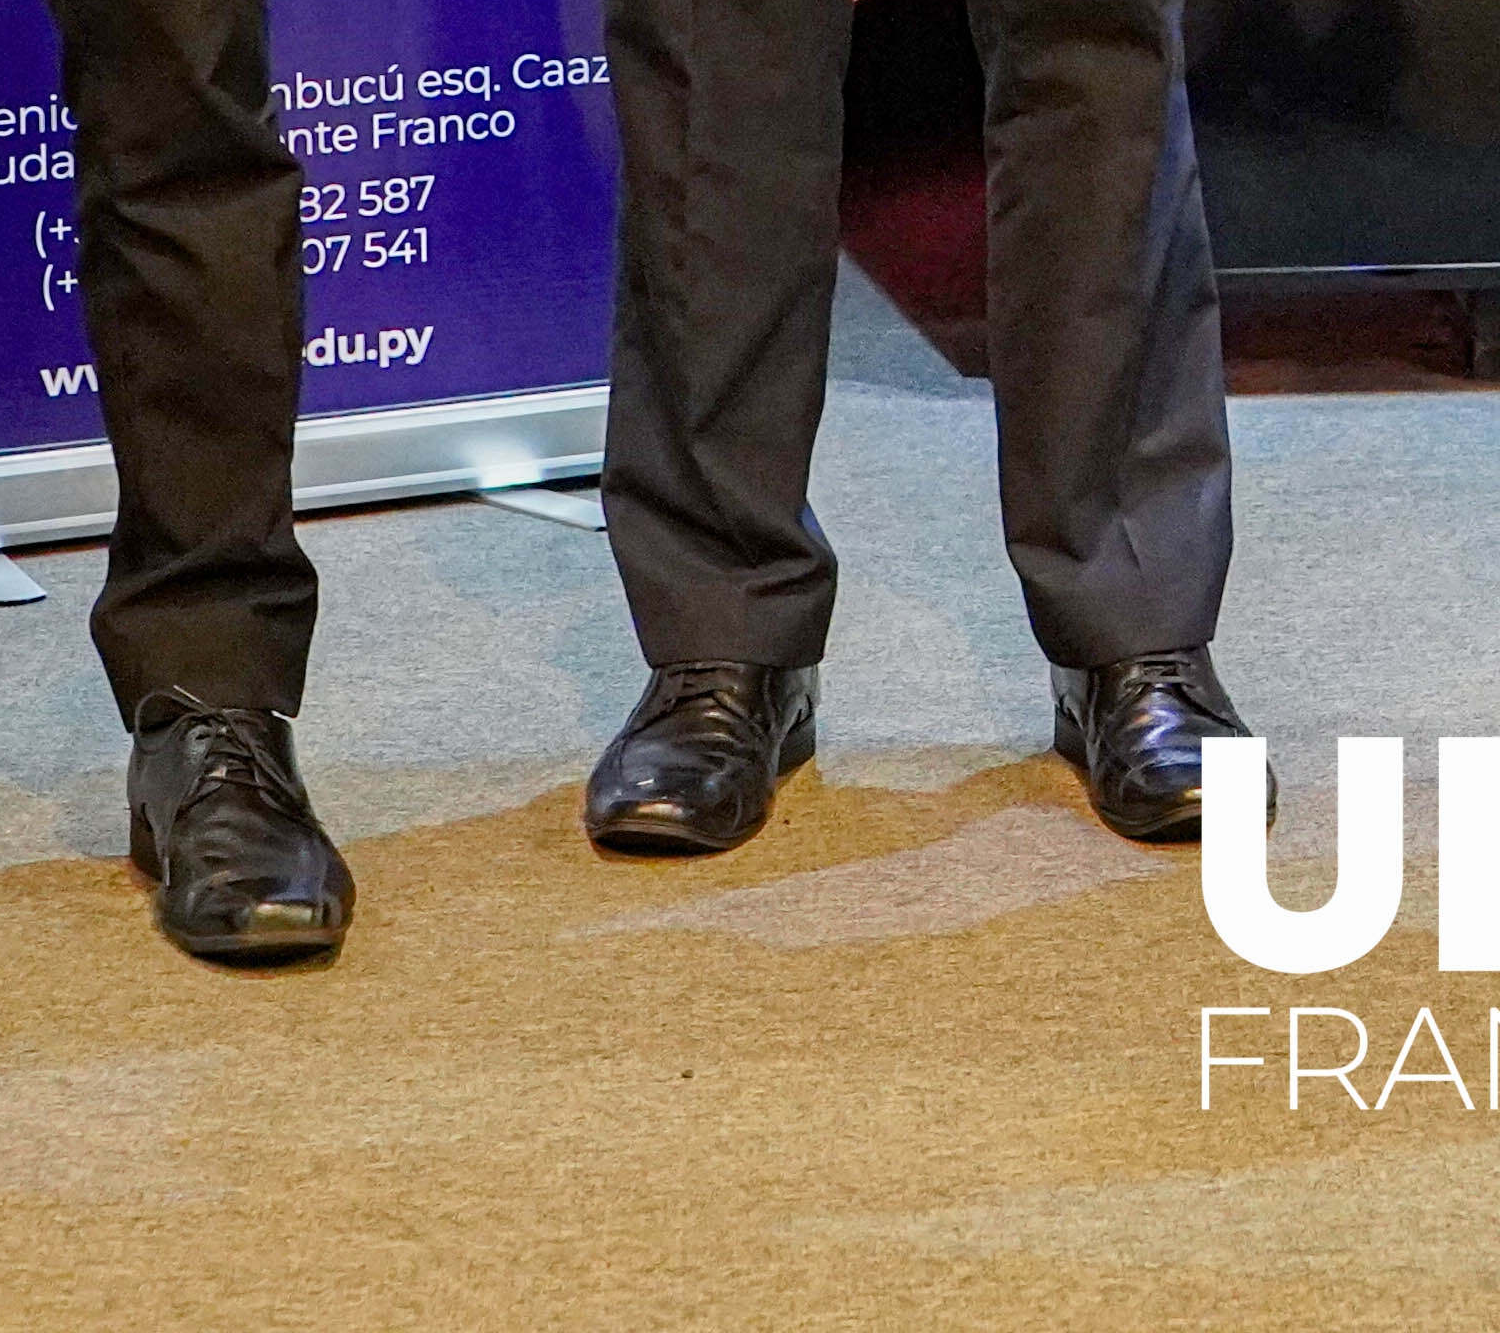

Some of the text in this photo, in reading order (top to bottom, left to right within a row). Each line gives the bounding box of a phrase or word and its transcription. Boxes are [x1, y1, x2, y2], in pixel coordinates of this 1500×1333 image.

[417, 66, 501, 102] esq.
[372, 110, 515, 149] Franco
[358, 175, 435, 216] 587
[363, 228, 428, 268] 541
